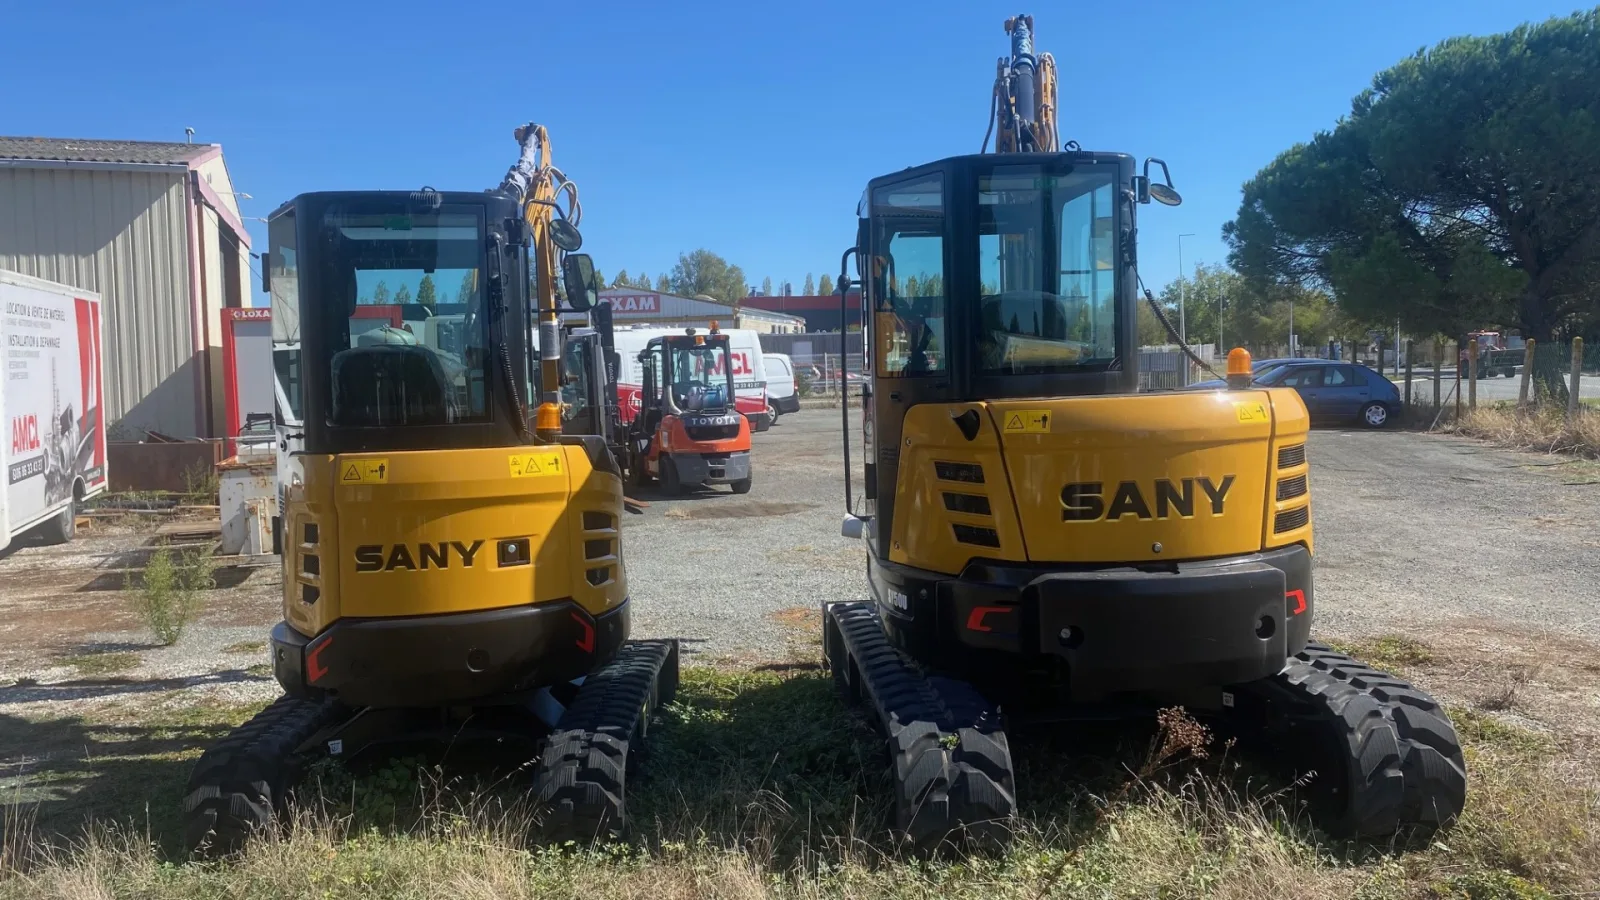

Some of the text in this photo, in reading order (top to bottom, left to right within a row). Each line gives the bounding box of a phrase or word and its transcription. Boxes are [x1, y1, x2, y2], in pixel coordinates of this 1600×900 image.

[242, 310, 270, 318] LOXA
[597, 296, 655, 310] XAM
[692, 415, 736, 425] TOYOTA
[12, 414, 40, 456] AMCL
[1058, 475, 1236, 524] SANY
[354, 540, 486, 573] SANY
